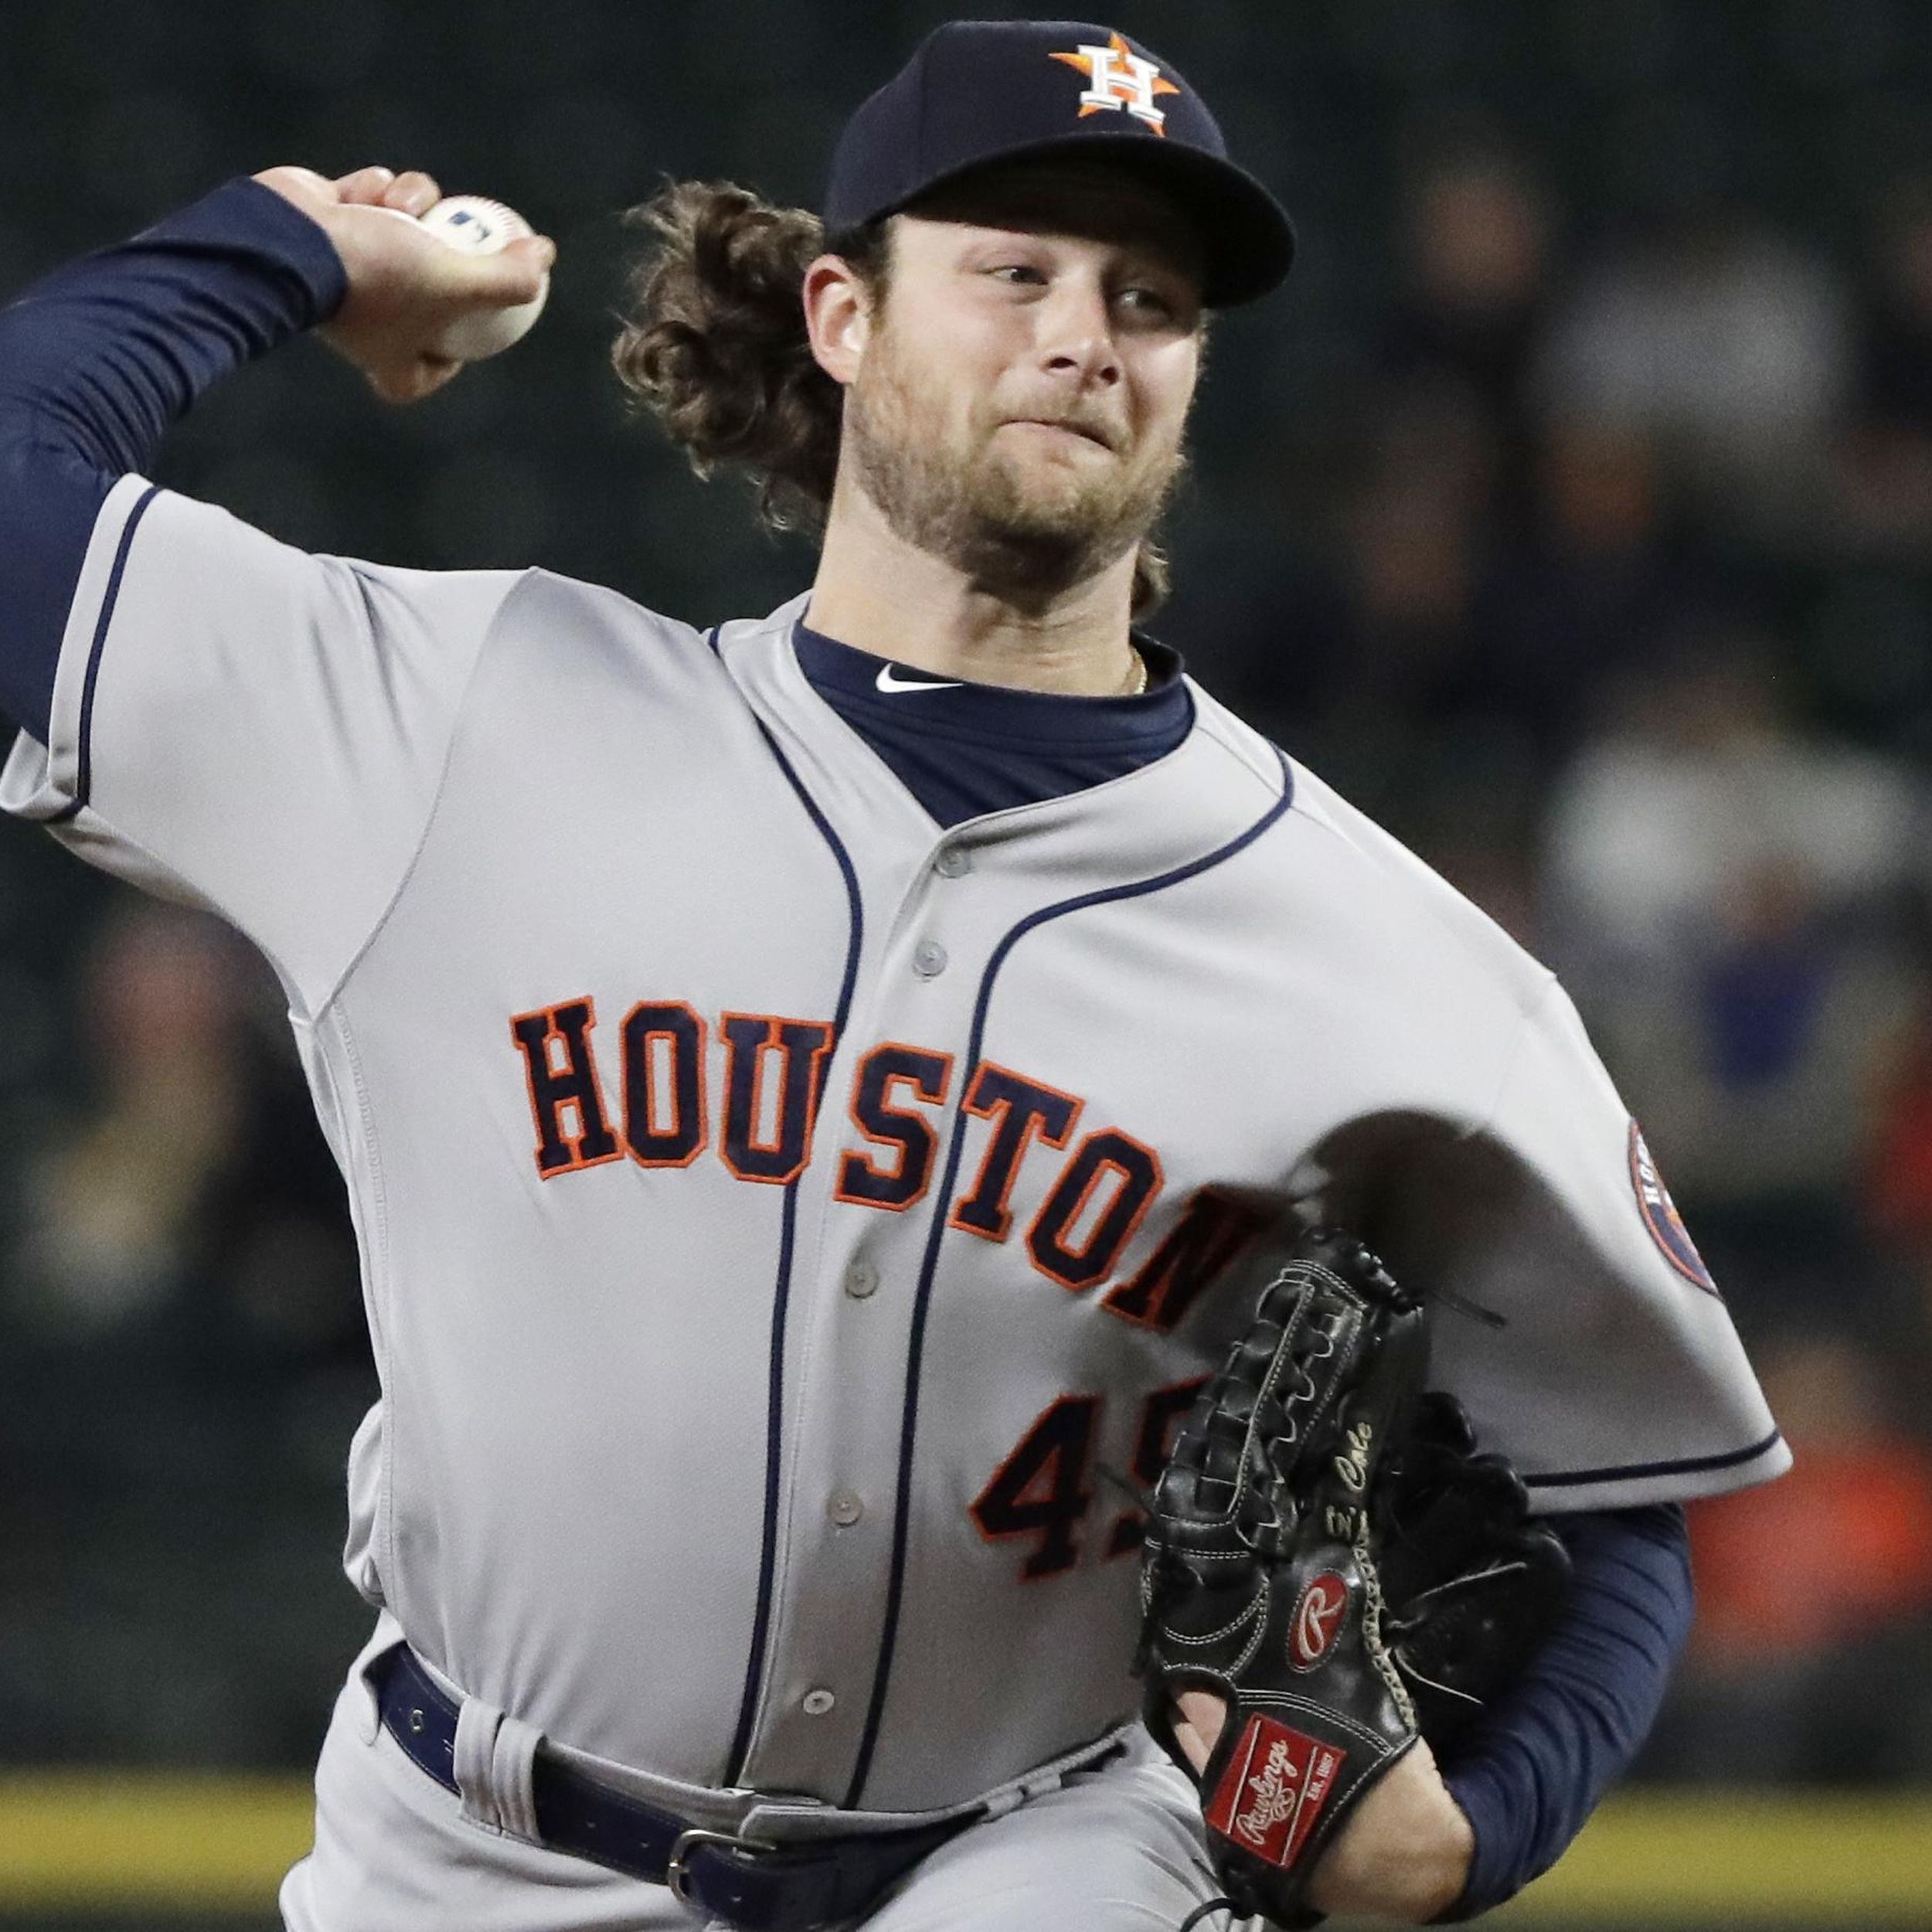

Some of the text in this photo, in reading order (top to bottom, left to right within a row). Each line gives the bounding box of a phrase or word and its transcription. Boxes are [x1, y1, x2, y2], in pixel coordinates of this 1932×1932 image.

[1077, 44, 1166, 124] H
[510, 995, 1279, 1335] HOUSTON
[1236, 1740, 1298, 1845] Rawlings
